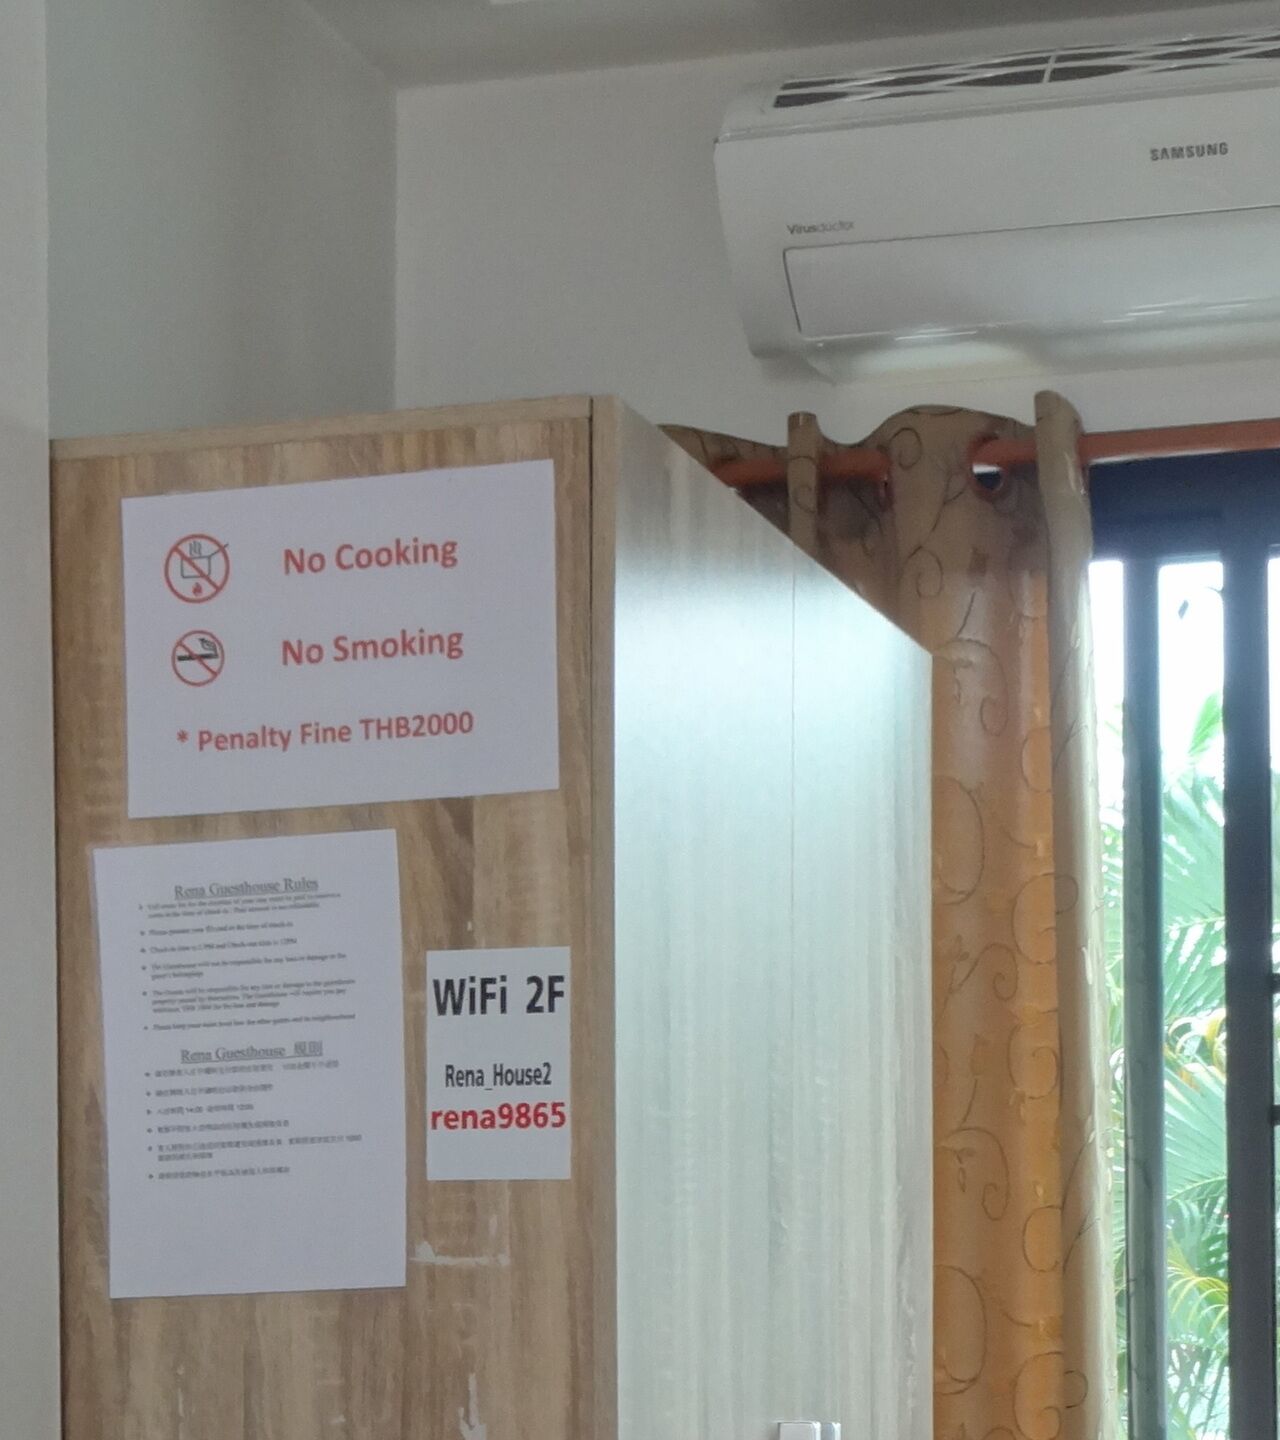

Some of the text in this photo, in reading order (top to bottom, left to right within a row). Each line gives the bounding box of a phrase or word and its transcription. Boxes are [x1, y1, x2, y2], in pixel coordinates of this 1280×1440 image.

[1150, 141, 1229, 161] SAMSUNG
[283, 537, 459, 576] No Cooking
[281, 629, 464, 666] No Smoking
[197, 711, 474, 753] Penalty Fine THB2000
[209, 880, 280, 896] Guesthouse
[283, 877, 319, 892] Rules
[432, 974, 566, 1016] WiFi 2F
[215, 1045, 286, 1061] Guesthouse
[431, 1101, 567, 1131] rena9865
